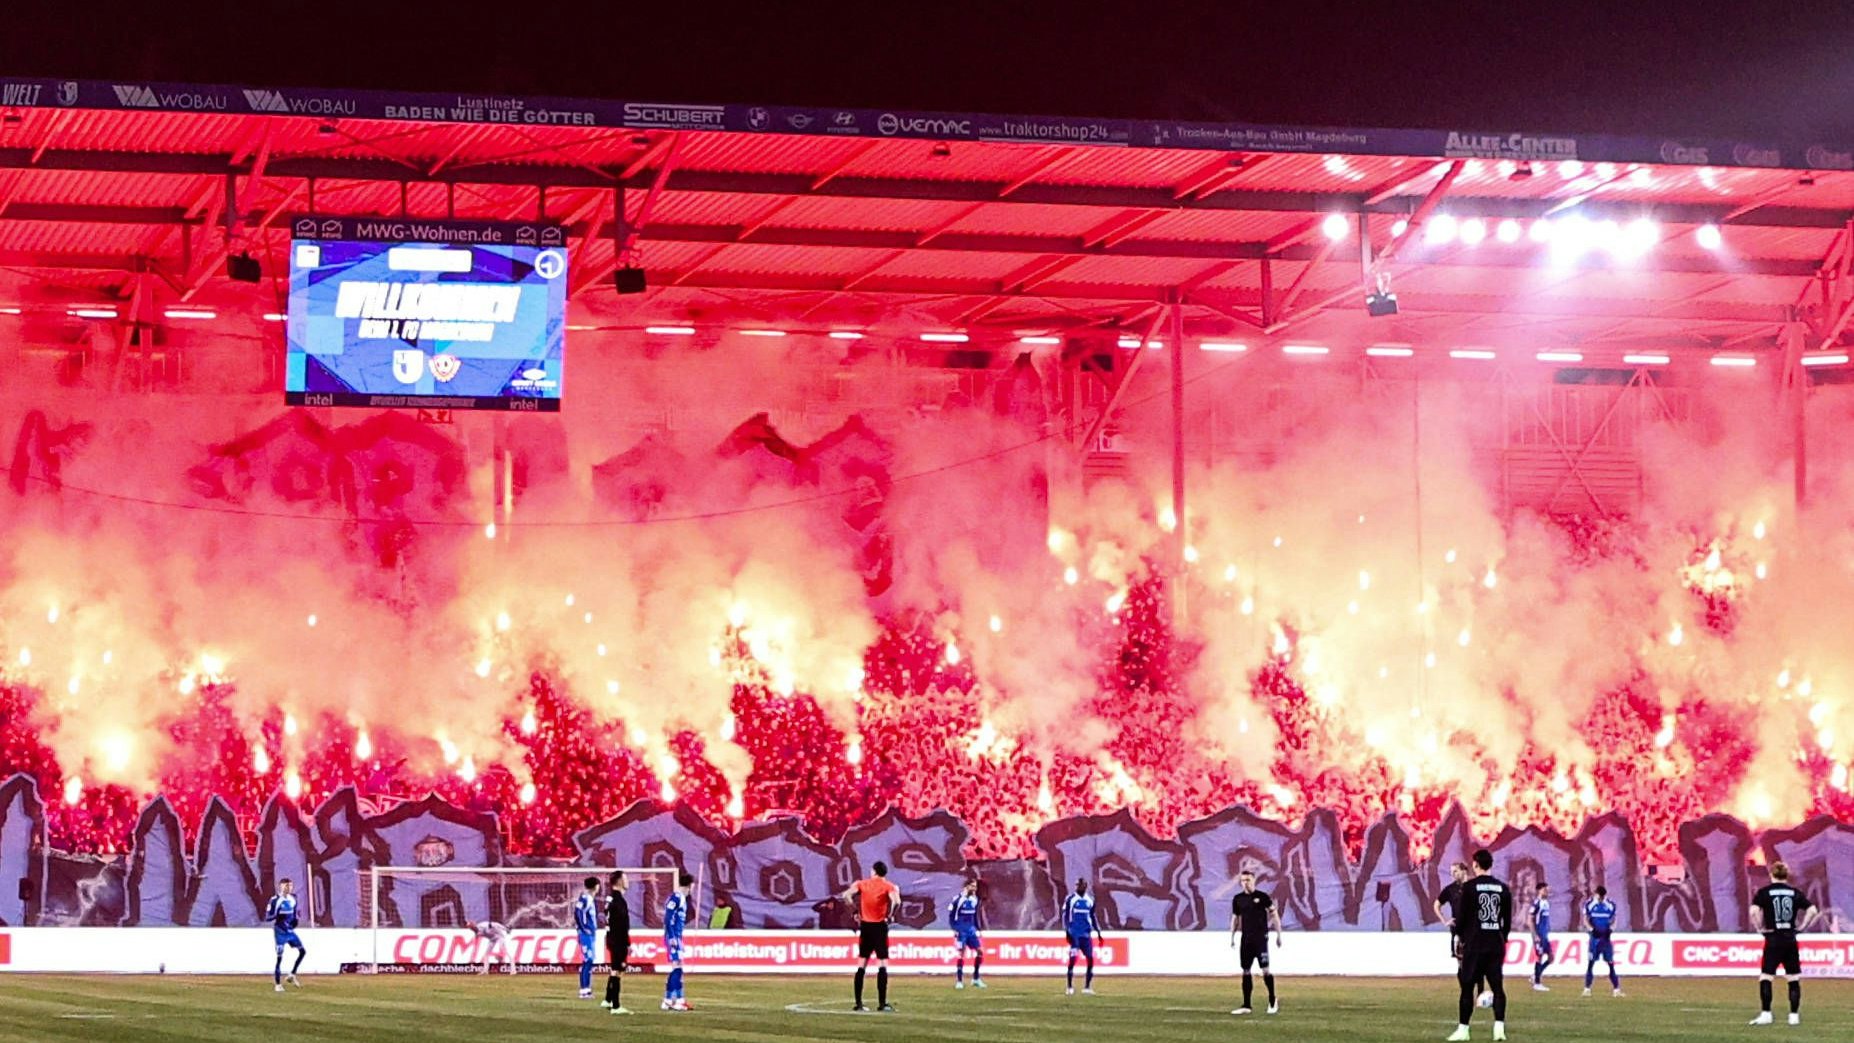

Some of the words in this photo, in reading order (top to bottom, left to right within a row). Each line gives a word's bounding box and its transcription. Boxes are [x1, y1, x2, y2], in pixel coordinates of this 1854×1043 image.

[2, 84, 42, 105] WELT
[160, 93, 227, 109] WOBAU
[290, 98, 356, 114] WOBAU
[385, 105, 446, 119] BADEN
[451, 108, 484, 121] WIE
[489, 109, 519, 122] DIE
[624, 103, 725, 123] SCHUBERT
[357, 223, 501, 242] MWG-Wohnen.de
[304, 394, 333, 406] intel
[510, 398, 538, 410] intel
[1479, 893, 1501, 922] 39
[1772, 896, 1793, 922] 18
[801, 943, 849, 959] Unser
[1000, 943, 1022, 959] Ihr
